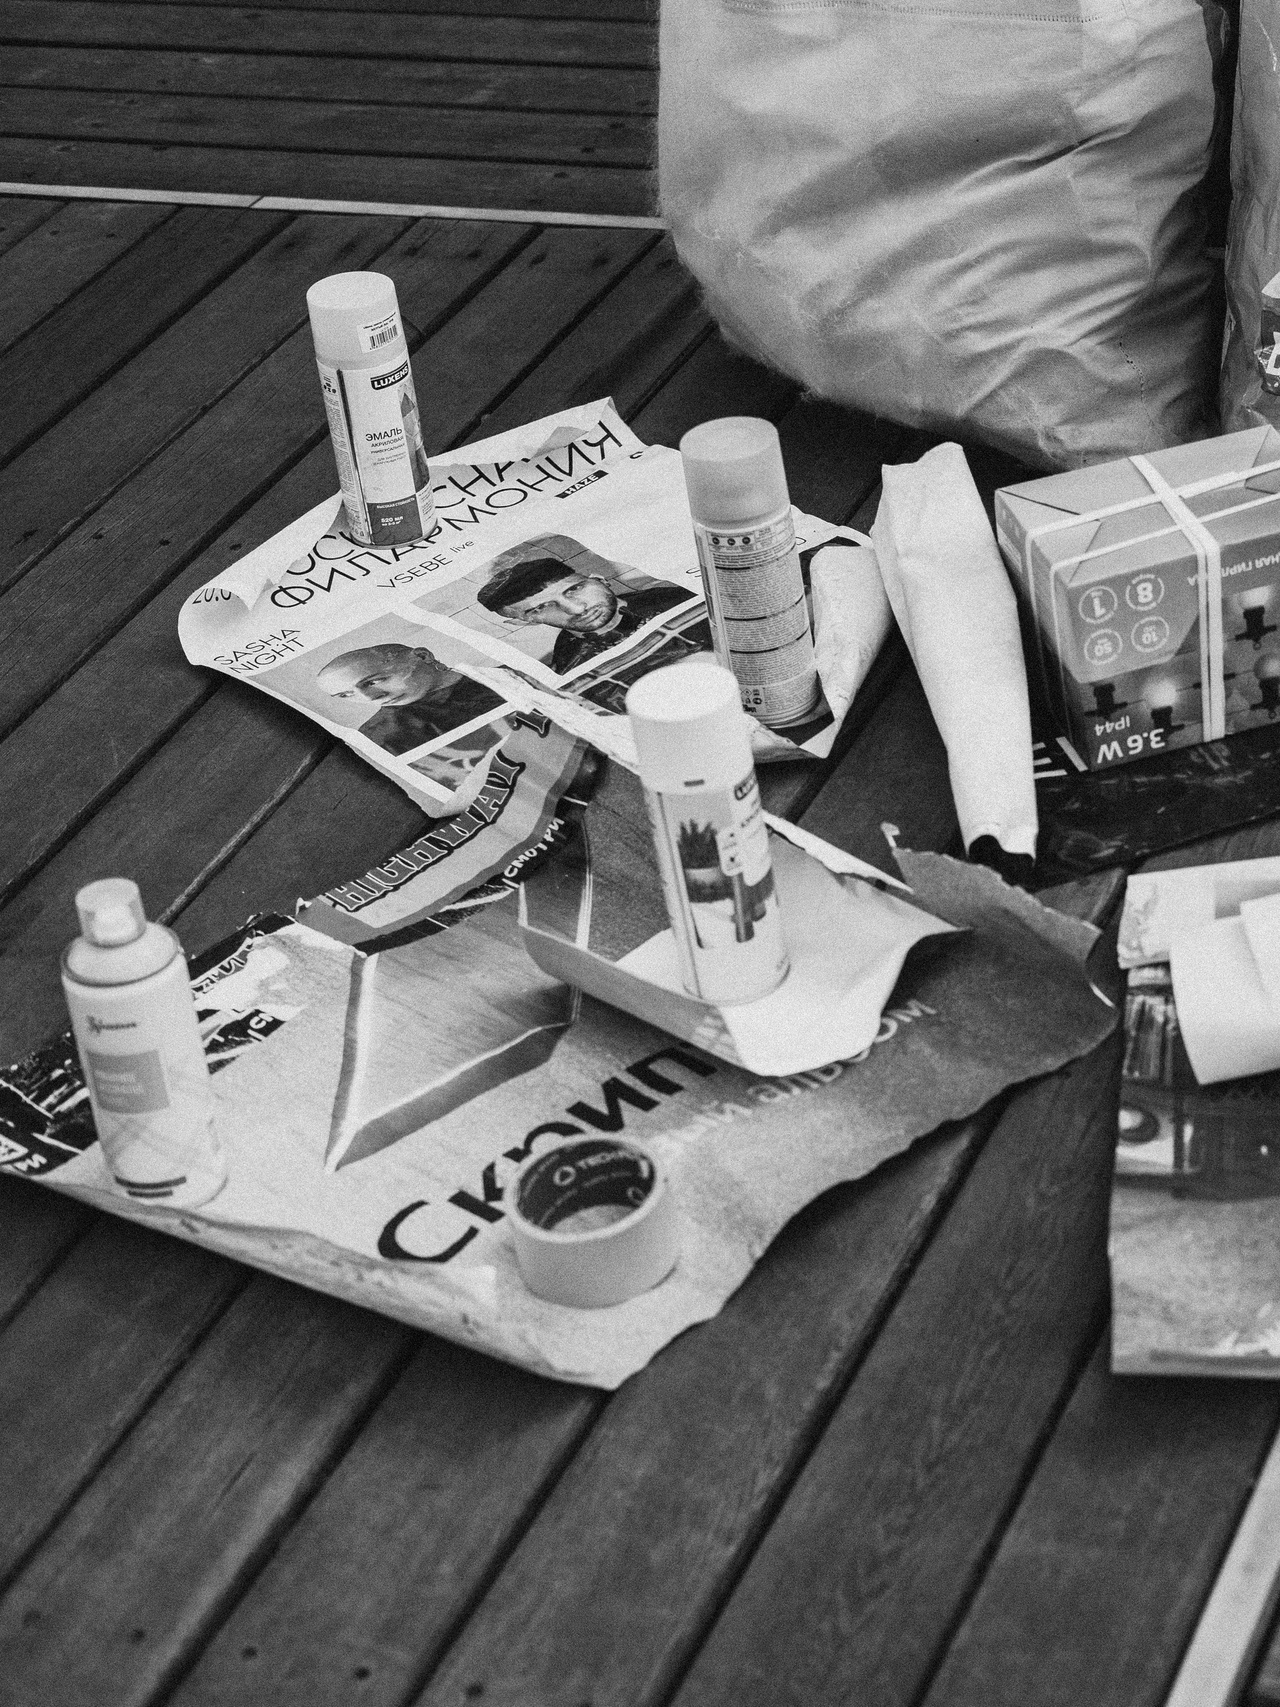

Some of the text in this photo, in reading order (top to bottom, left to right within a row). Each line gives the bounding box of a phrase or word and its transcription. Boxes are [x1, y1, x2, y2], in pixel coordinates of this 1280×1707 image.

[373, 365, 409, 389] LUXENS
[365, 427, 403, 442] ЭМАЛЬ
[565, 473, 599, 495] HAZE
[376, 539, 475, 590] VSEBE live
[1187, 560, 1253, 587] ГИРЛА
[1136, 582, 1154, 604] 8
[213, 629, 301, 666] SASHA
[229, 636, 305, 674] NIGHT
[1094, 715, 1131, 737] IP44
[1096, 740, 1124, 764] W
[1126, 728, 1166, 756] 3.6
[325, 750, 522, 912] HIGHWAY
[503, 817, 565, 878] СМОТРИ
